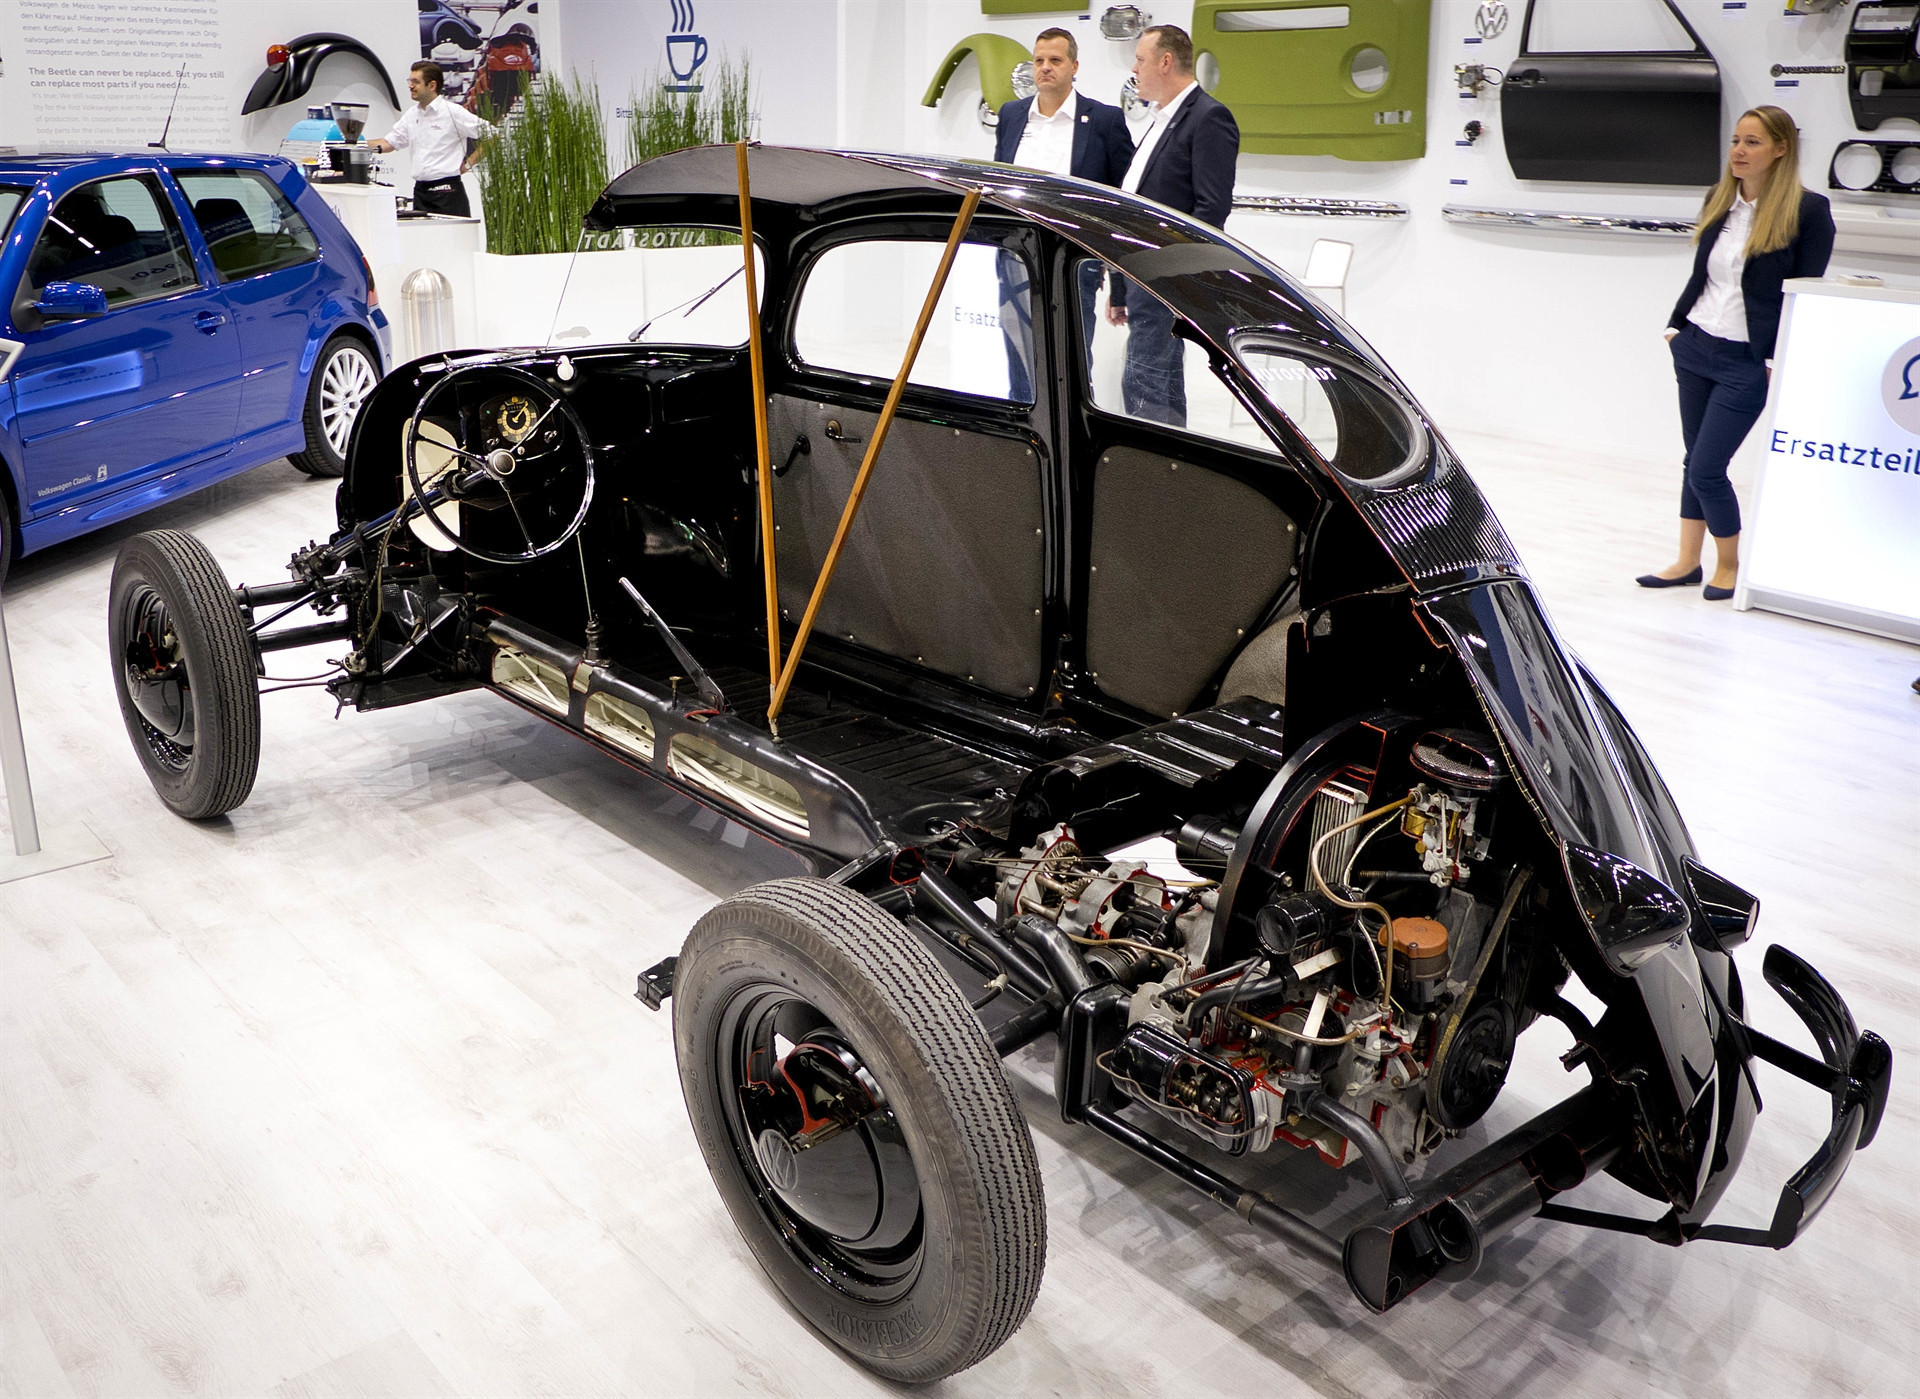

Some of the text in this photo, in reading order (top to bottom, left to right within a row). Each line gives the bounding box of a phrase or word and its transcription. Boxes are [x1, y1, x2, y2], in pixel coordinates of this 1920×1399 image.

[29, 67, 45, 75] The
[176, 70, 190, 78] But
[48, 80, 80, 88] replace
[955, 306, 1000, 327] Ersatz
[1770, 429, 1920, 475] Ersatzteil
[38, 473, 92, 497] Volkswagen Classic
[827, 1302, 924, 1347] EXCELSIOR
